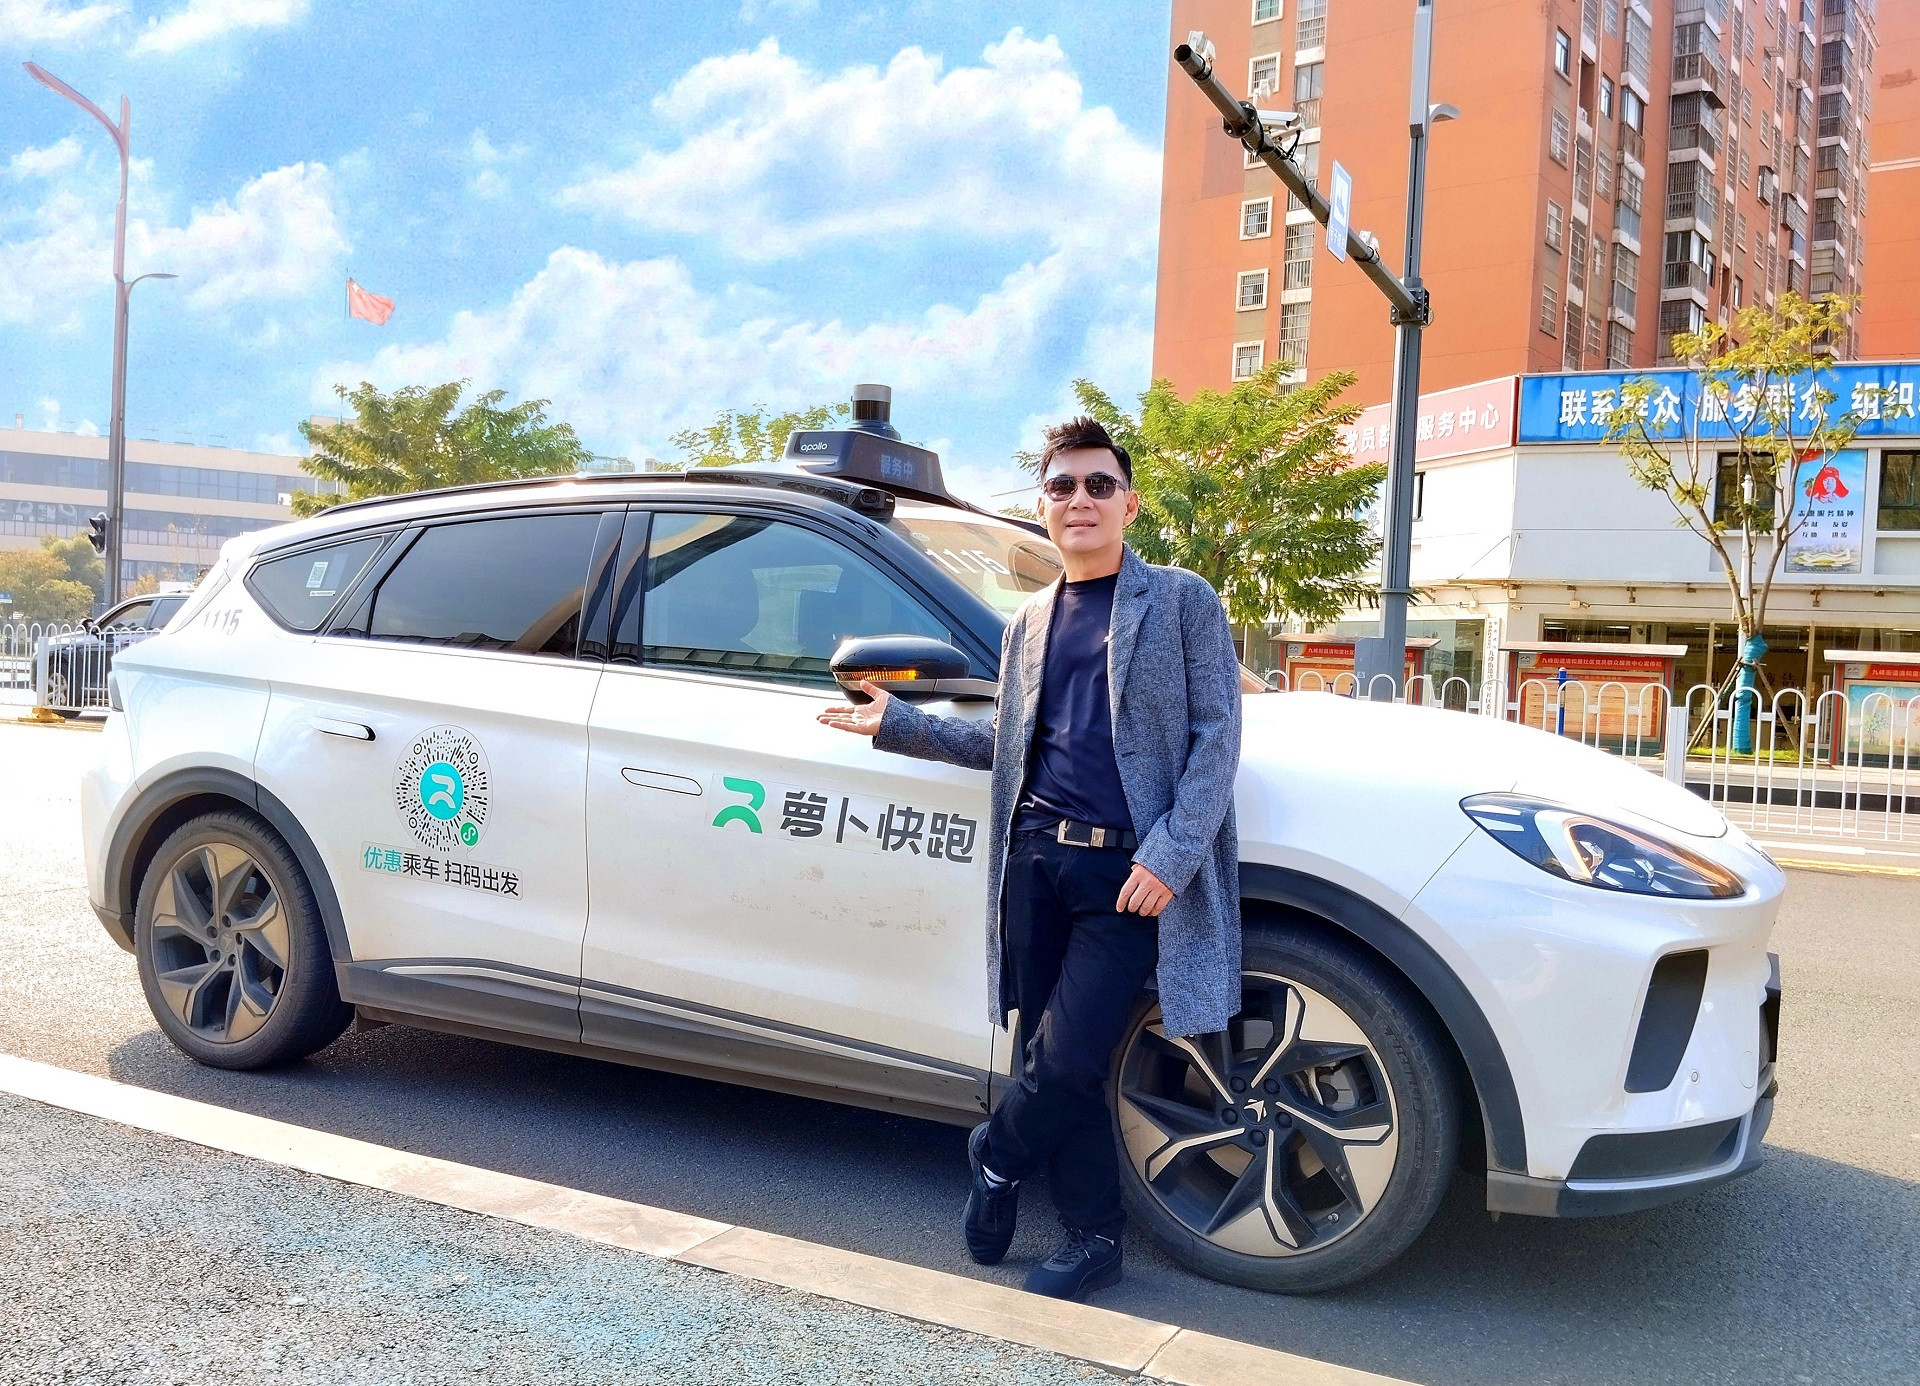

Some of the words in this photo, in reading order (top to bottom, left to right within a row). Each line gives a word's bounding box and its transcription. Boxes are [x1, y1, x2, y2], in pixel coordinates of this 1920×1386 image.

[1851, 380, 1920, 420] 组织
[1344, 402, 1501, 454] 党员群服务中心
[801, 442, 828, 452] apollo
[880, 454, 914, 477] 服务中
[925, 549, 1011, 575] 1115
[203, 609, 243, 636] 1115
[780, 791, 977, 863] 萝卜快跑
[364, 846, 440, 880] 优惠乘车
[444, 860, 519, 896] 扫码出发
